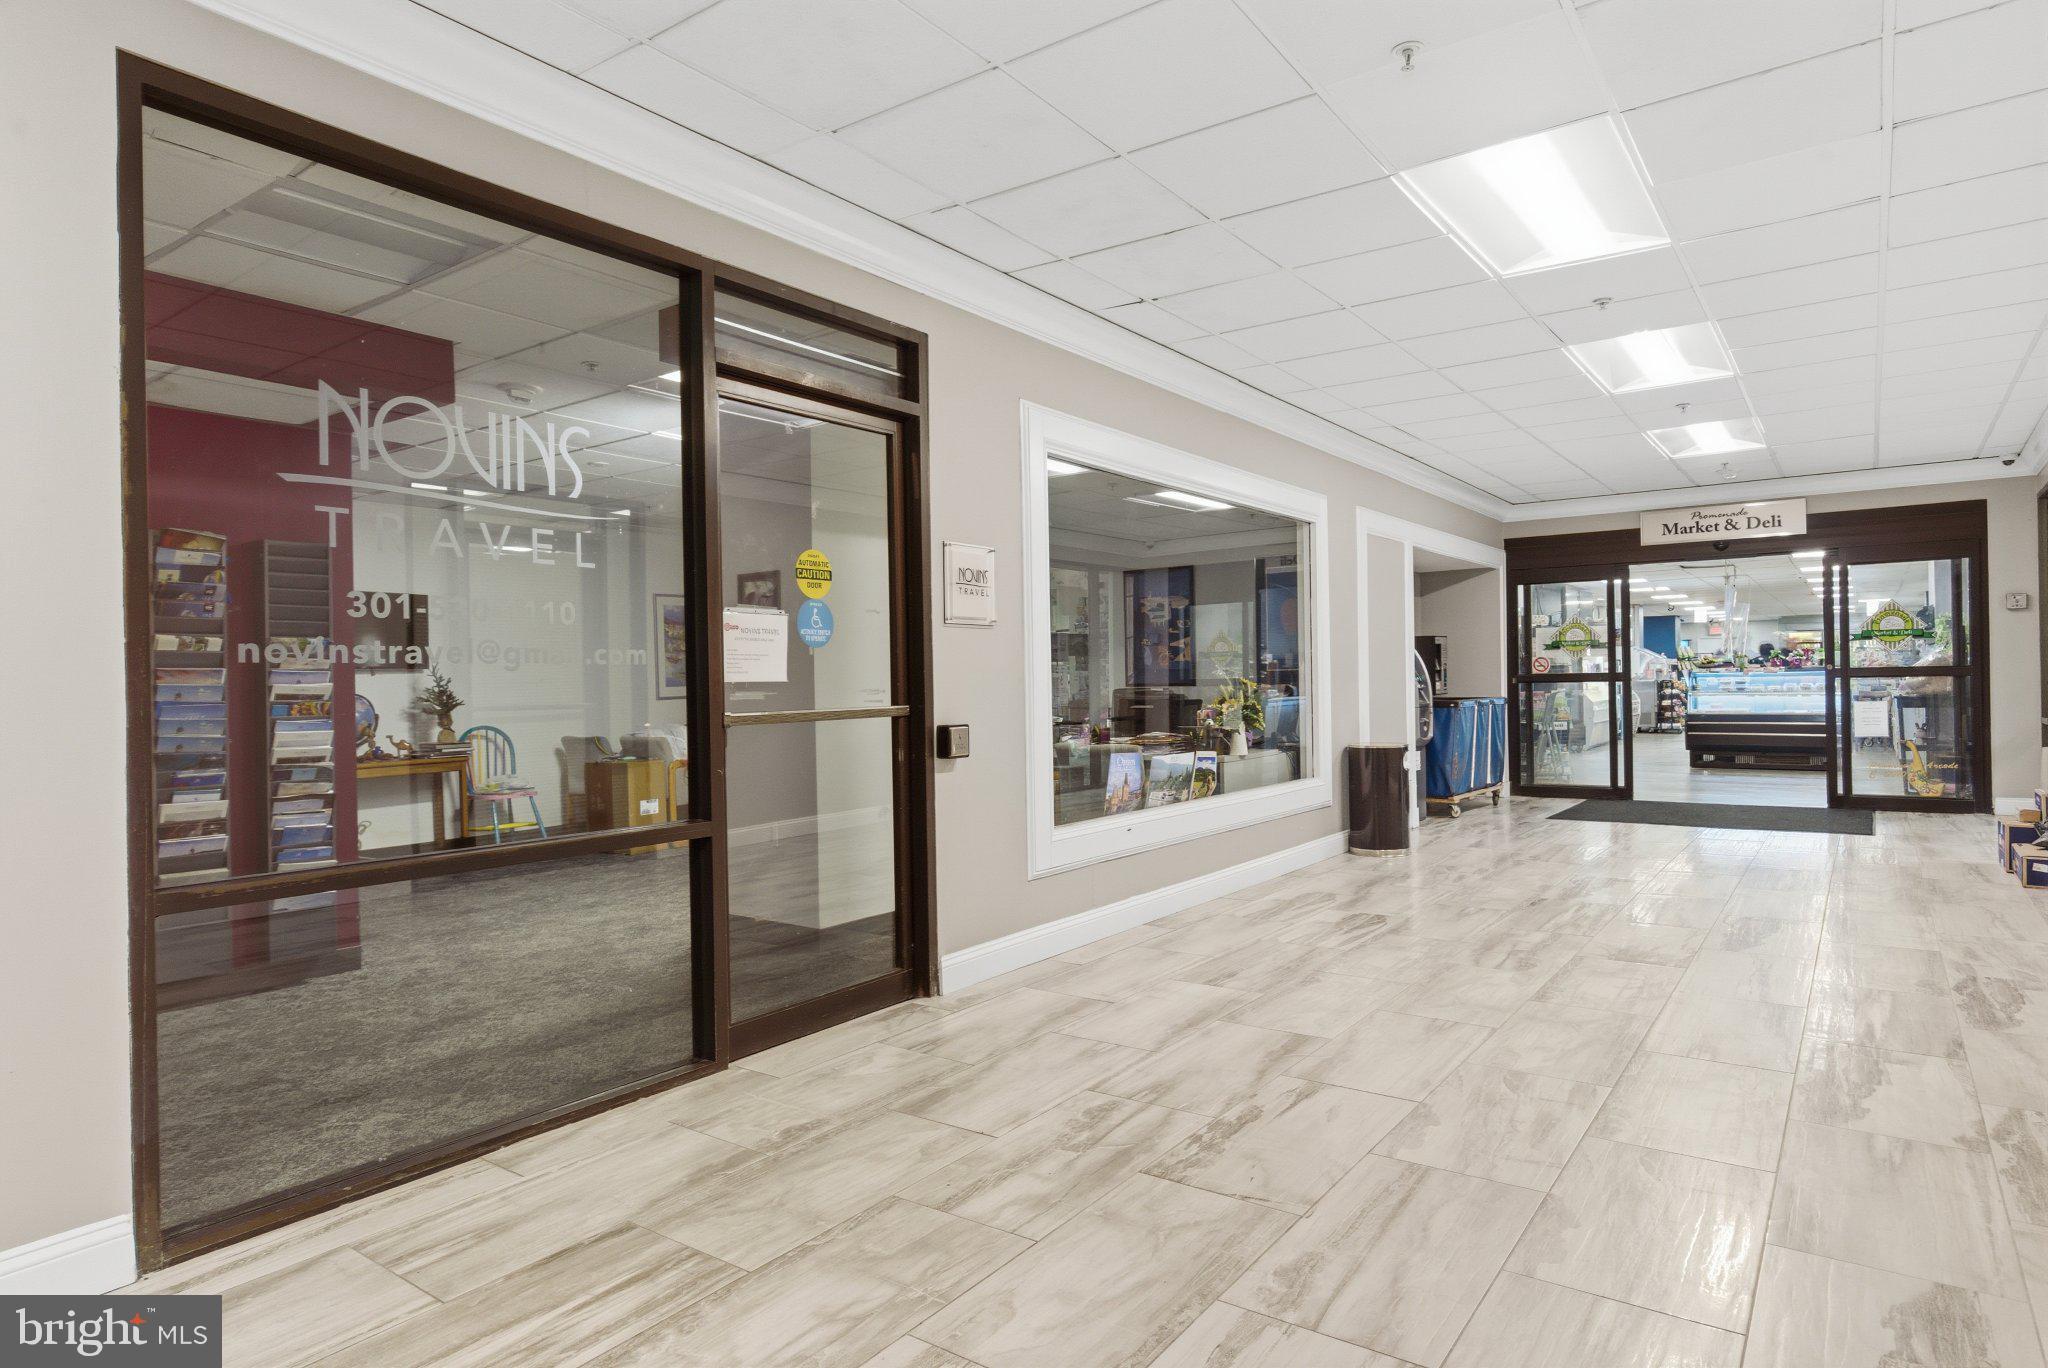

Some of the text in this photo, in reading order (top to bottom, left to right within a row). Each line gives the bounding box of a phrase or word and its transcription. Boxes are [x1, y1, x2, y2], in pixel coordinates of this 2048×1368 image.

[318, 378, 590, 498] NOVINS
[1661, 514, 1783, 536] Market & Deli
[314, 504, 596, 569] TRAVEL
[798, 559, 830, 568] AUTOMATIC
[796, 568, 831, 580] CAUTION
[958, 567, 989, 584] NOVINS
[806, 581, 823, 590] DOOR
[958, 586, 990, 598] TRAVEL
[237, 638, 648, 672] novinstravel@gm.com
